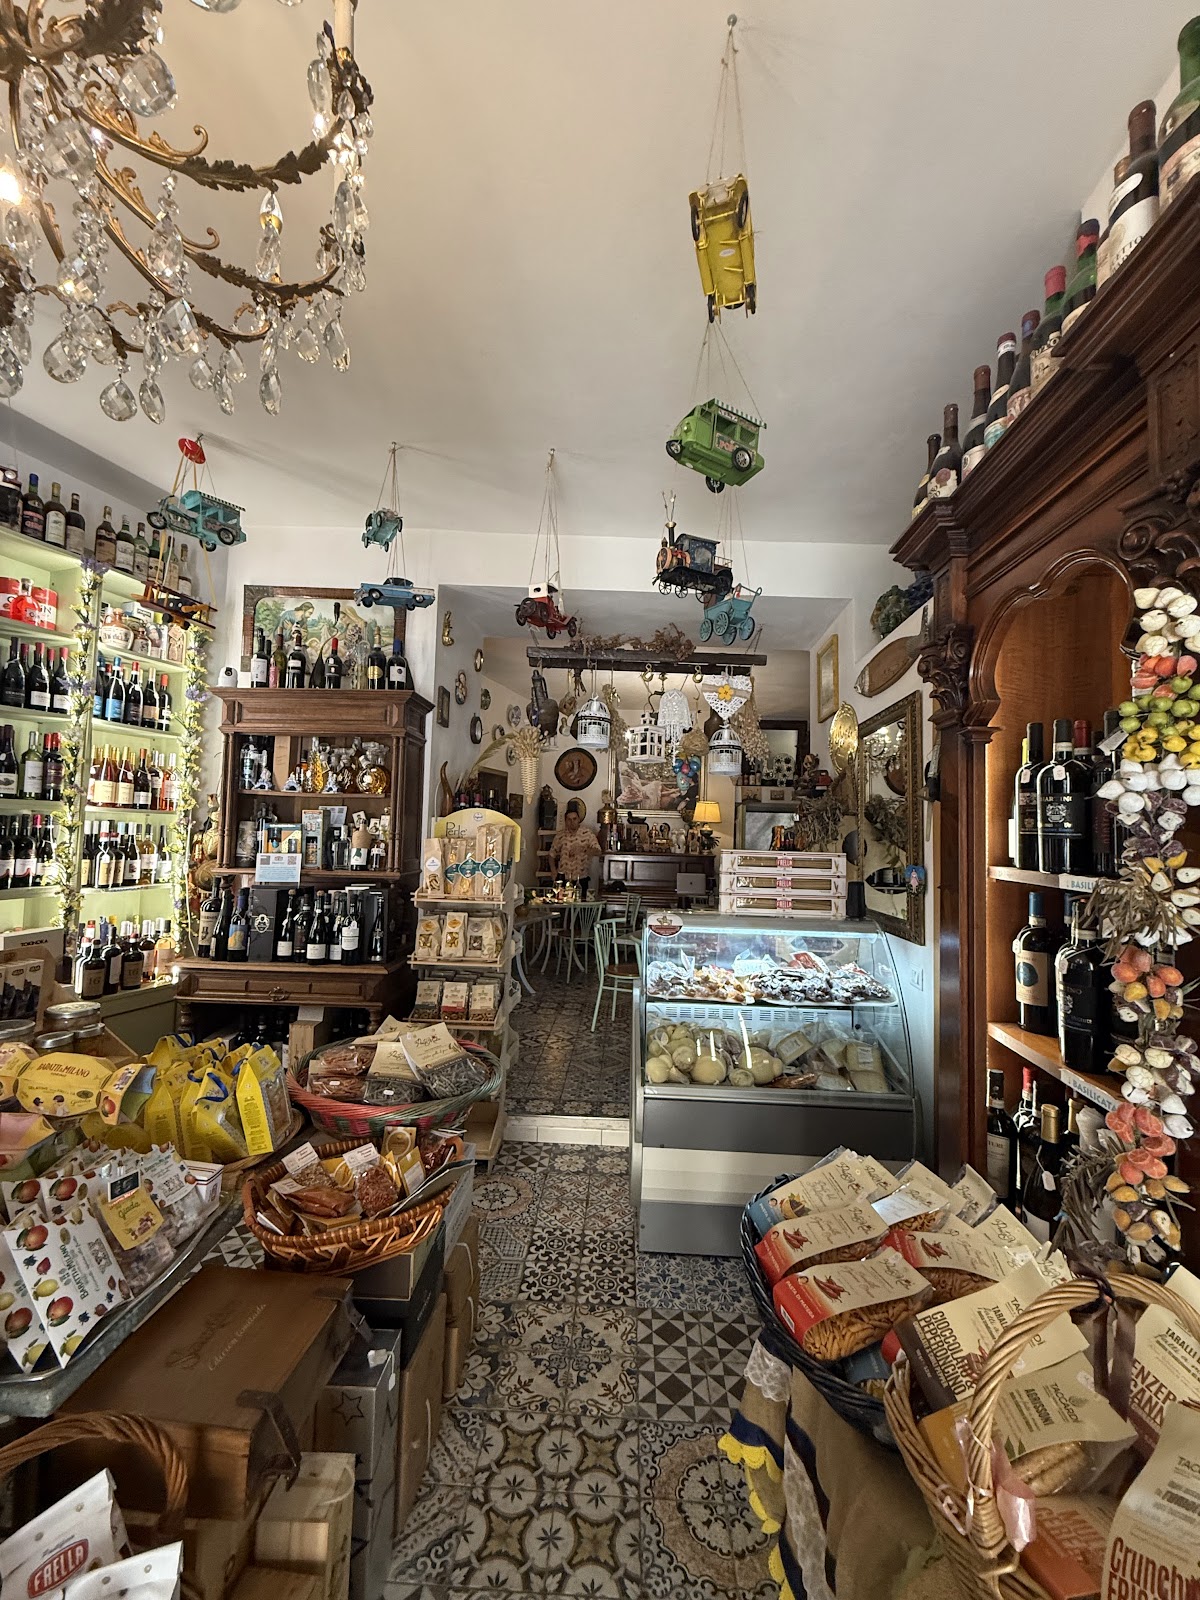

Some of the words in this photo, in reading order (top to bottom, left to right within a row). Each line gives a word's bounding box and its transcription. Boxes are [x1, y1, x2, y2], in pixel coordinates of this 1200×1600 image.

[1071, 880, 1096, 891] BASILI
[785, 1280, 798, 1295] PASTA
[799, 1299, 815, 1319] MATERA
[918, 1315, 967, 1396] PEPERONCINO
[931, 1310, 970, 1380] CIOCCOLATO
[1165, 1327, 1196, 1361] TARALLI
